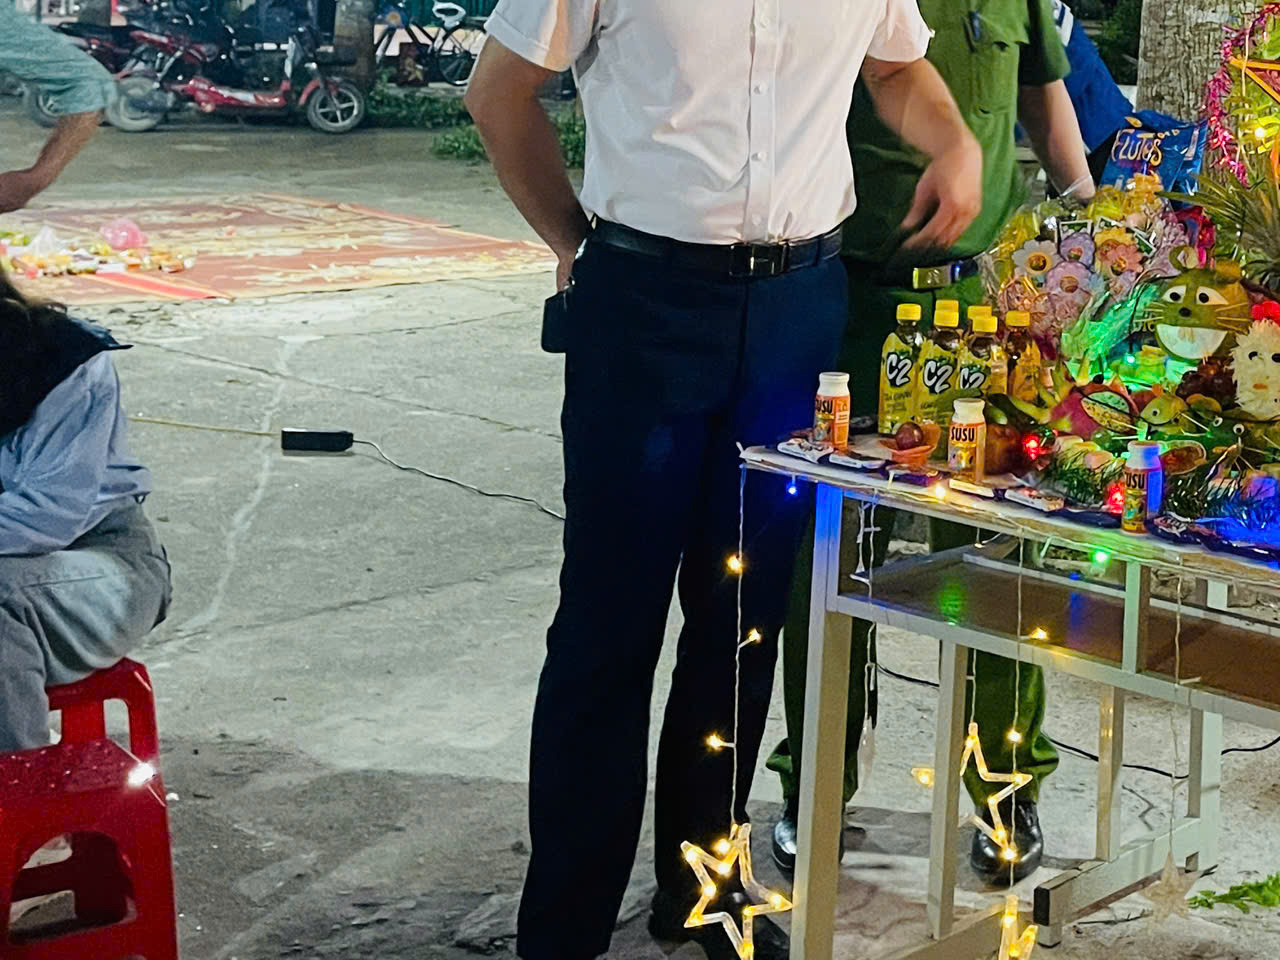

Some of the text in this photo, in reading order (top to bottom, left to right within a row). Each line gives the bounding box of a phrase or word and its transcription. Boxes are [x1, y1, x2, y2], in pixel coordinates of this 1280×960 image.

[886, 352, 914, 387] C2
[922, 359, 954, 395] C2
[959, 366, 986, 390] C2
[815, 399, 834, 414] USU
[950, 426, 975, 442] SUSU
